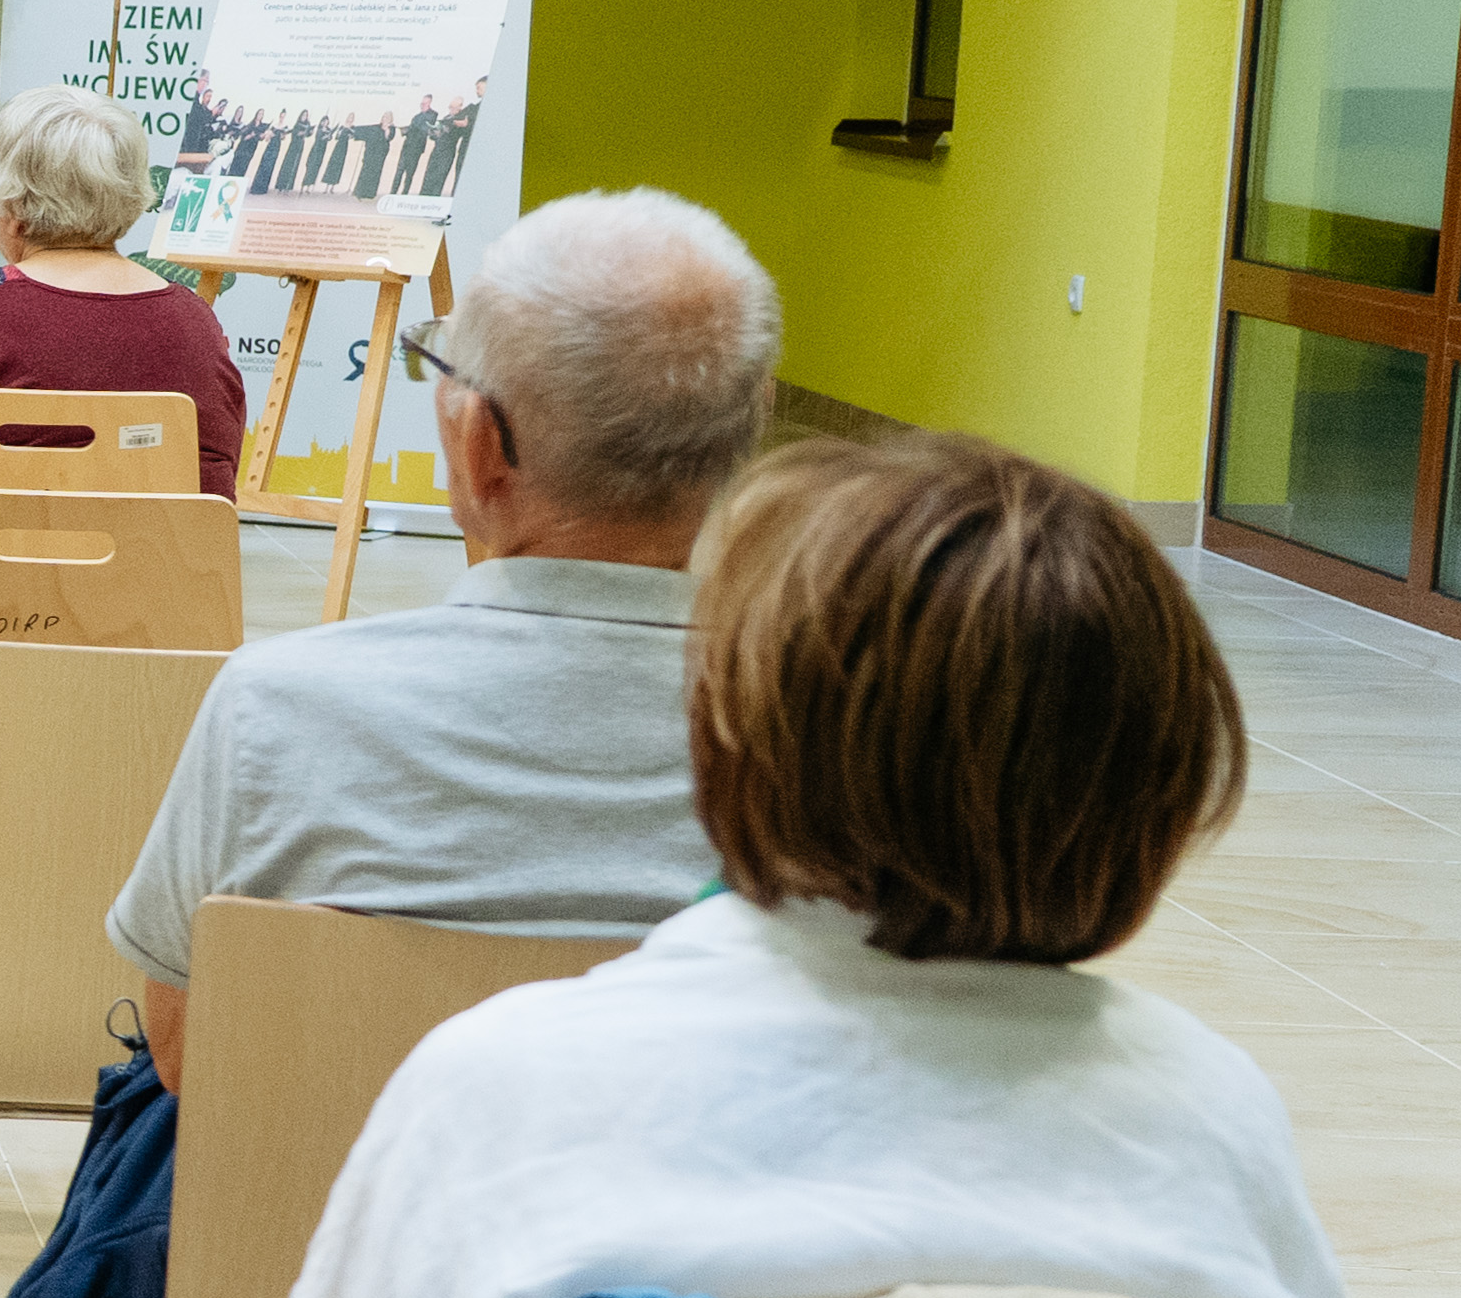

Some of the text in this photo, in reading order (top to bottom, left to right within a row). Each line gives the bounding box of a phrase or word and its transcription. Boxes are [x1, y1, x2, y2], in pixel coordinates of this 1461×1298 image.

[123, 5, 203, 30] ZIEMI
[88, 33, 197, 66] IM. ŚW.
[62, 69, 199, 101] WOJEWÓ
[238, 337, 281, 355] NSO
[237, 356, 276, 365] NARODOW
